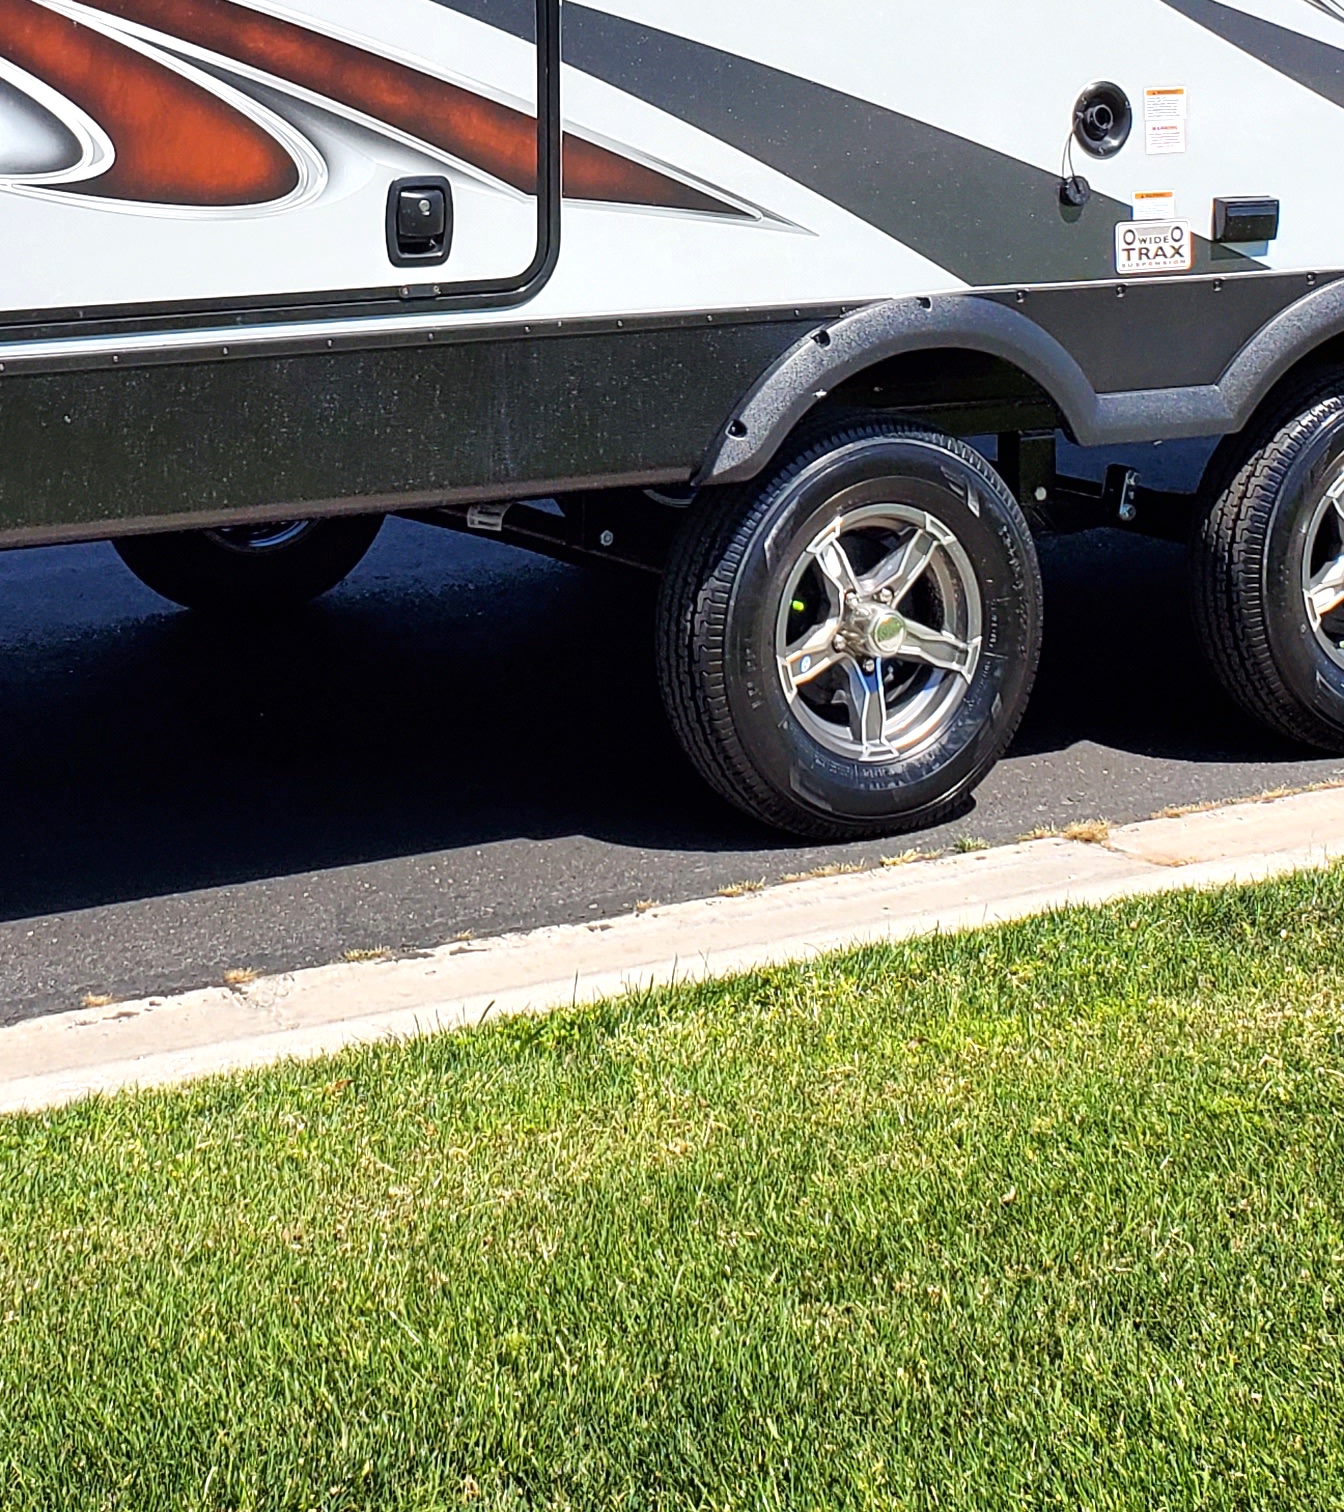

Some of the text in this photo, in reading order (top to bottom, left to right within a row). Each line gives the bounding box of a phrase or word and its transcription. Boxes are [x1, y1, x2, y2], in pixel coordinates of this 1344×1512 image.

[1138, 235, 1170, 245] WIDE
[1121, 244, 1186, 262] TRAX
[1121, 259, 1186, 268] SUSPENSION
